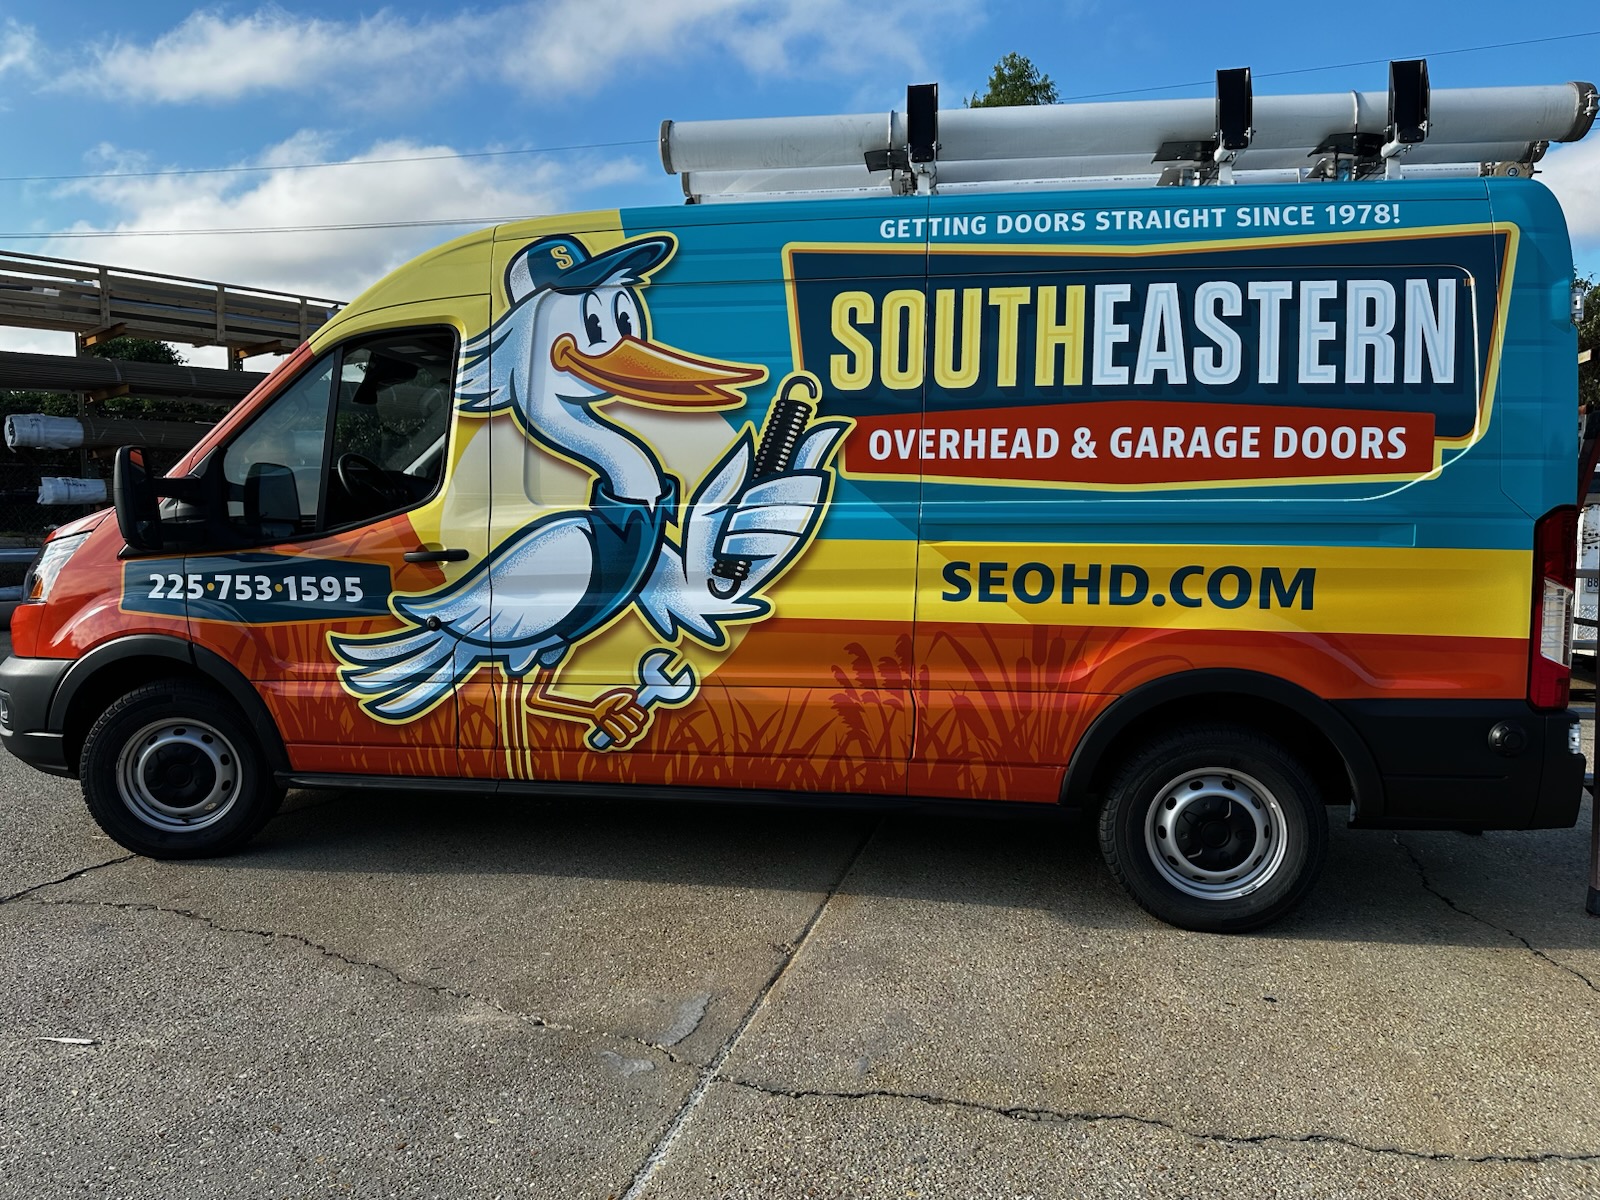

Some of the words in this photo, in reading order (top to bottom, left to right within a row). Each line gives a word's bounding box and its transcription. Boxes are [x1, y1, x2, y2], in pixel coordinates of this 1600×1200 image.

[879, 215, 987, 239] GETTING
[997, 212, 1086, 234] DOORS
[1095, 207, 1227, 230] STRAIGHT
[1236, 205, 1315, 227] SINCE
[1325, 203, 1401, 225] 1978!
[550, 245, 574, 270] S
[829, 278, 1457, 391] SOUTHEASTERN
[868, 427, 1060, 461] OVERHEAD
[1070, 427, 1098, 460] &
[1109, 426, 1261, 459] GARAGE
[1273, 426, 1407, 459] DOORS
[941, 561, 1317, 611] SEOHD.COM
